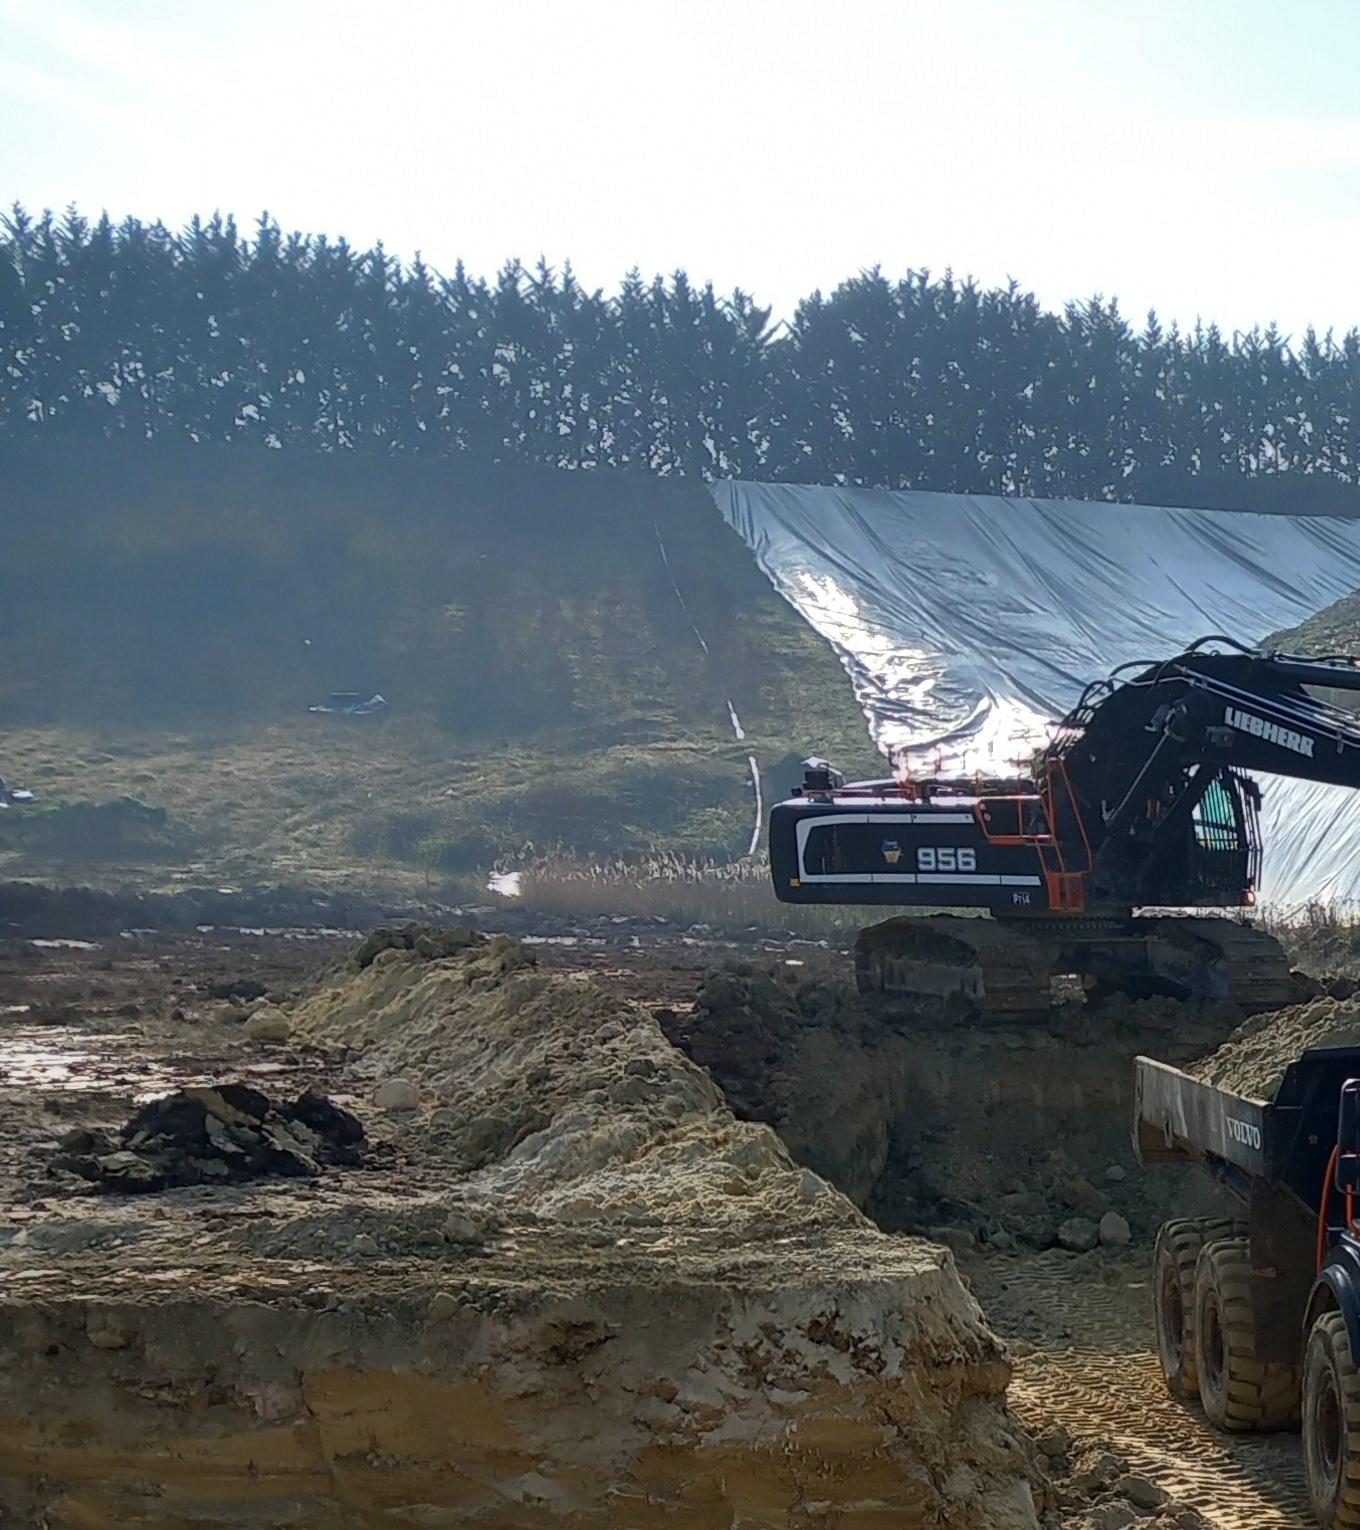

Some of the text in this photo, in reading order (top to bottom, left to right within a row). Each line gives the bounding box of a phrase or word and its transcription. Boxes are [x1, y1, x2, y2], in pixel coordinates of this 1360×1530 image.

[1224, 706, 1315, 758] LIEBHERR
[917, 847, 977, 871] 956
[1226, 1116, 1261, 1150] VOLVO
